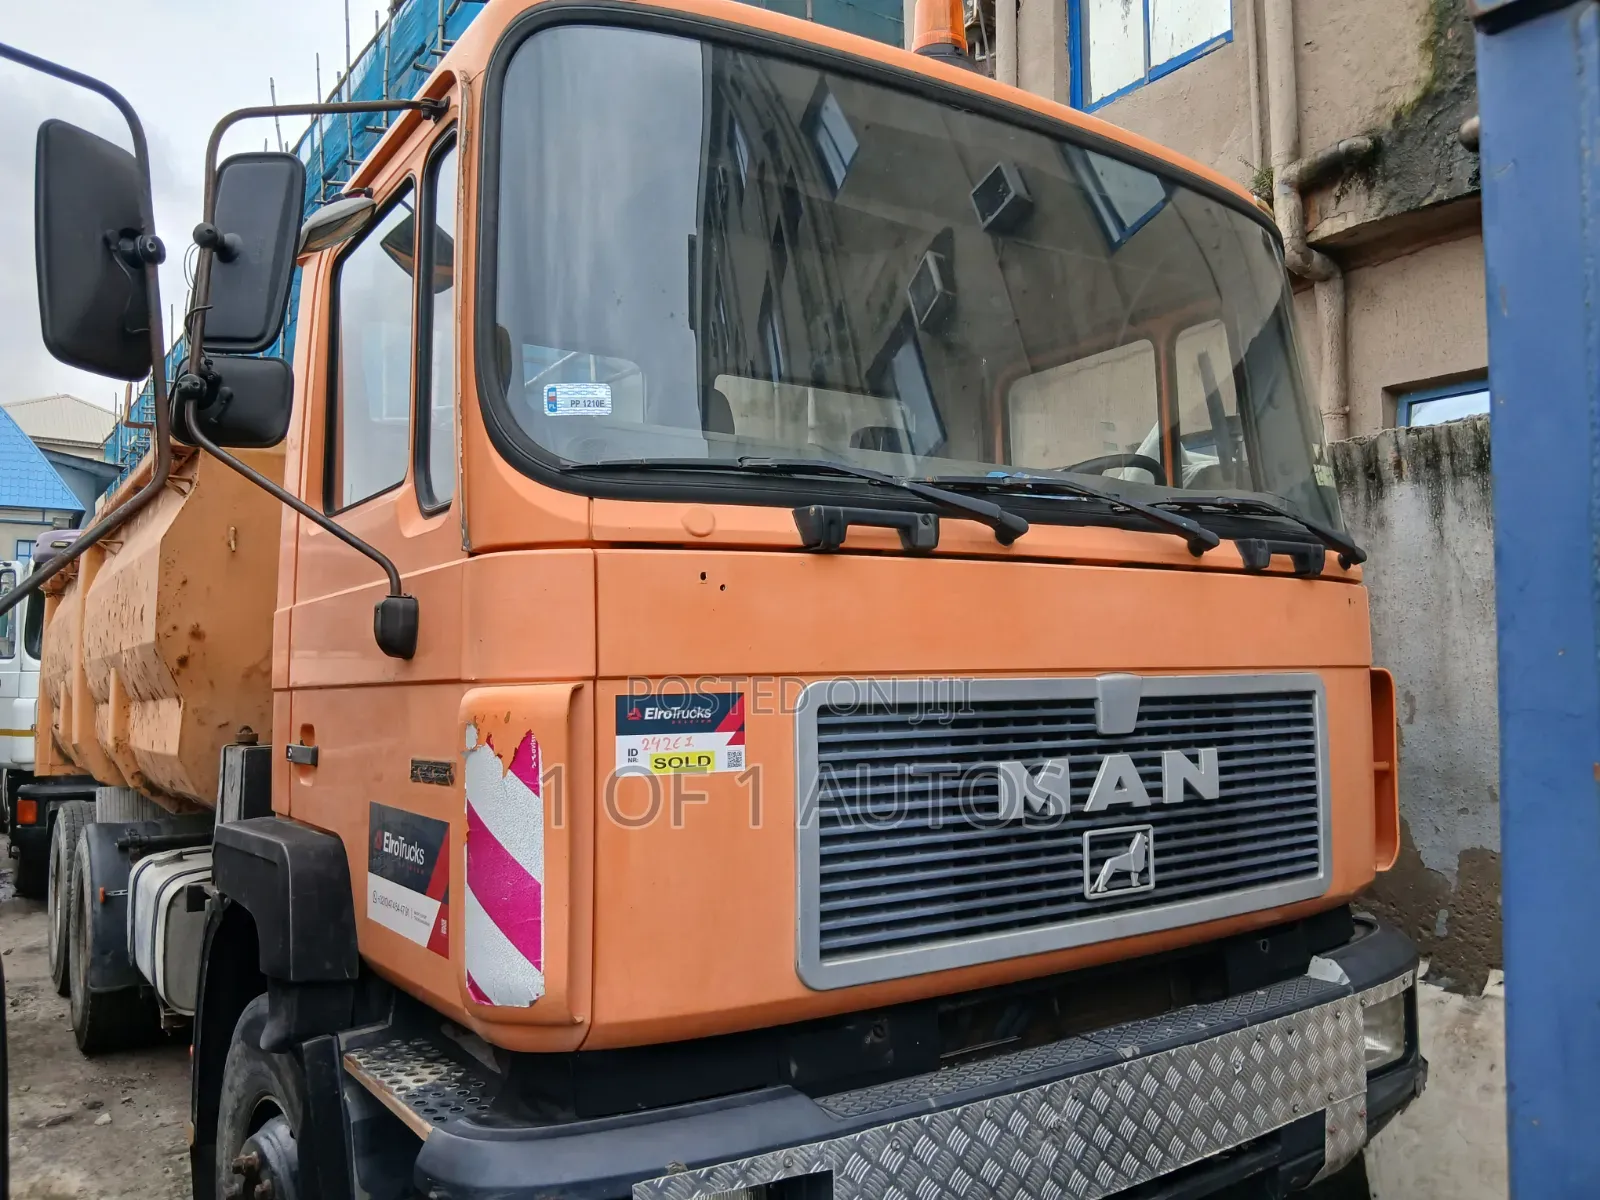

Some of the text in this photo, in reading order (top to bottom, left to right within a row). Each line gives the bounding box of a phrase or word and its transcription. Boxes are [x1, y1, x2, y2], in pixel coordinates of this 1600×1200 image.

[644, 706, 712, 720] ElroTrucks
[627, 748, 639, 757] ID
[653, 755, 711, 769] SOLD
[998, 747, 1220, 820] MAN
[383, 831, 425, 865] ElroTrucks
